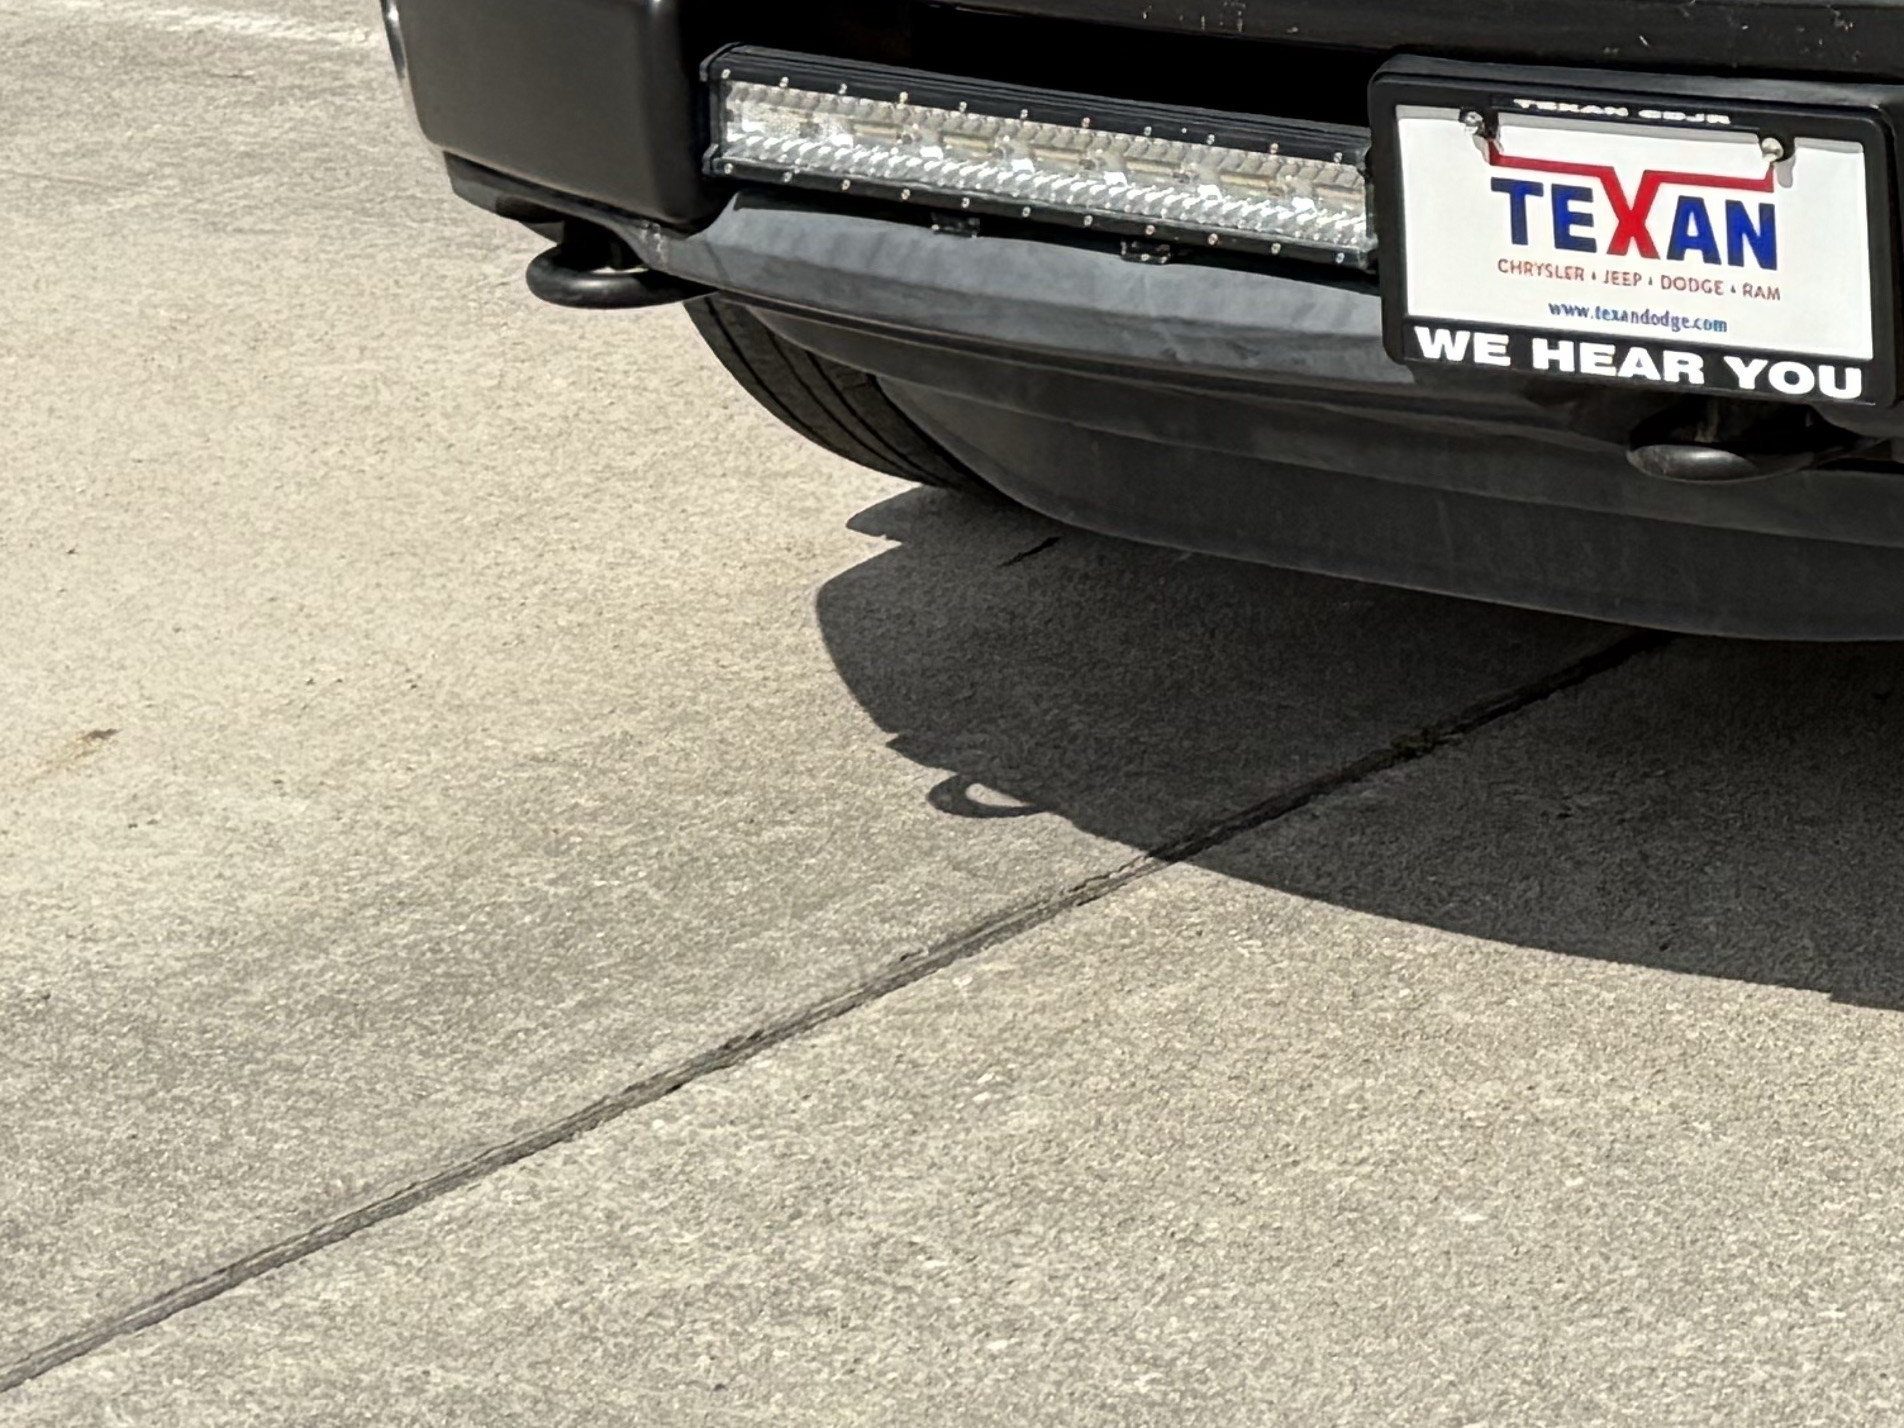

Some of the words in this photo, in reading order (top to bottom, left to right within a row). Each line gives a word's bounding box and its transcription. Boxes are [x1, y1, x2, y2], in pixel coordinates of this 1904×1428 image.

[1512, 98, 1629, 117] TEXAN
[1488, 136, 1779, 271] TEXAN
[1497, 258, 1585, 282] CHRYSLER
[1603, 269, 1643, 287] JEEP
[1660, 274, 1725, 296] DODGE
[1742, 282, 1781, 301] RAM
[1548, 302, 1728, 333] www.texandodge.com
[1413, 325, 1512, 368] WE
[1531, 337, 1706, 386] HEAR
[1725, 355, 1863, 400] YOU
